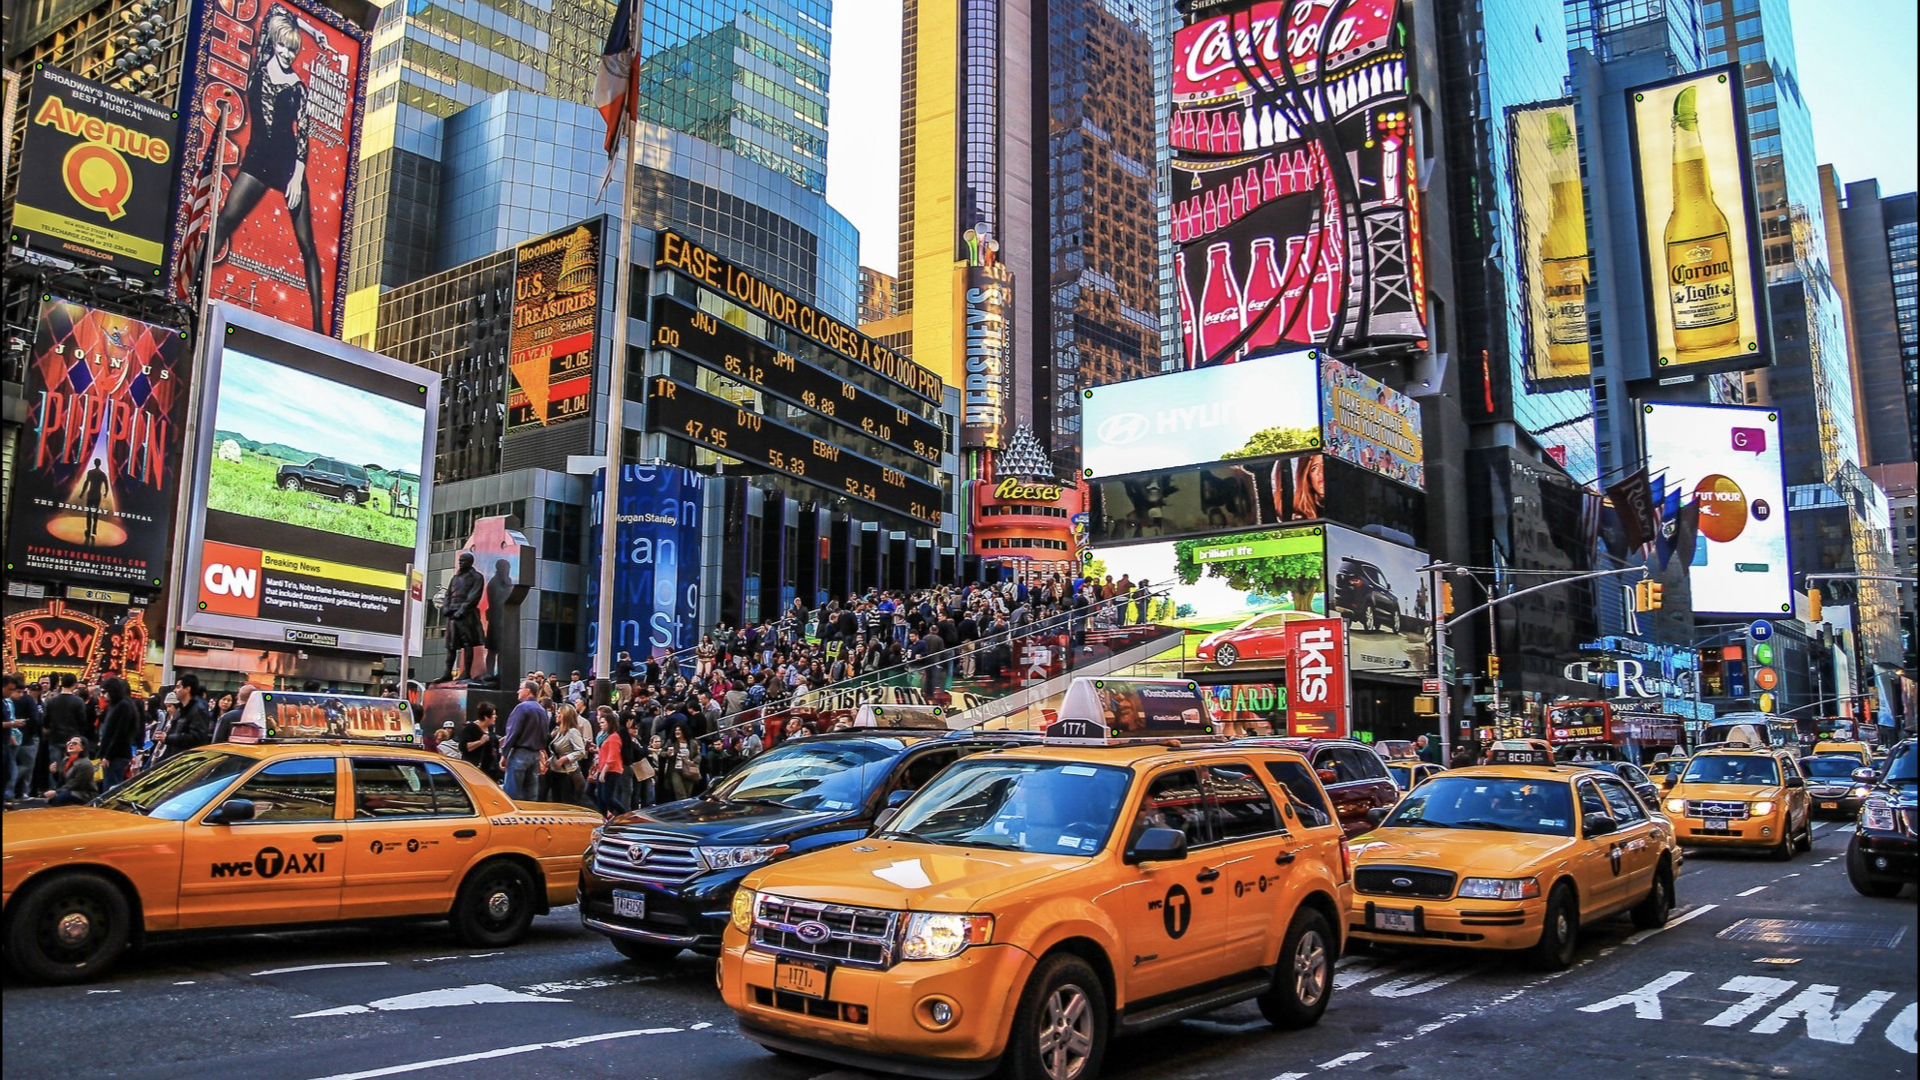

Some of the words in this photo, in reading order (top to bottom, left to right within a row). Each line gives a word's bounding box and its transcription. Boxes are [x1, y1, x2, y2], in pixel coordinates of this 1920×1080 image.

[43, 70, 103, 98] BROADWAY'S
[311, 60, 350, 92] LONGEST
[309, 74, 347, 107] RUNNING
[72, 90, 98, 105] BEST
[100, 99, 143, 121] MUSICAL
[305, 100, 343, 132] MUSICAL
[307, 90, 345, 119] AMERICAN
[35, 96, 170, 164] Avenue
[63, 142, 133, 221] Q
[41, 224, 95, 244] TELECHARGE.COM
[62, 242, 114, 260] AVENUEQ.COM
[519, 233, 575, 262] Bloomberg
[1672, 260, 1730, 286] Corona
[517, 272, 545, 301] U.S.
[656, 231, 723, 289] EASE:
[727, 265, 798, 328] LOUNOR
[800, 306, 858, 359] CLOSES
[861, 339, 871, 365] A
[1685, 283, 1720, 303] Light
[534, 326, 553, 340] YIELD
[560, 315, 593, 332] CHANGE
[691, 311, 717, 336] JNJ
[560, 350, 589, 370] -0.05
[966, 286, 1002, 424] HERSHEY'S
[1004, 319, 1012, 376] CHOCOLATE
[55, 344, 123, 369] JOIN
[141, 365, 170, 380] US
[724, 355, 764, 386] 85.12
[773, 351, 795, 373] JPM
[649, 379, 677, 400] TR
[802, 390, 835, 416] 48.88
[842, 382, 856, 400] KO
[1338, 389, 1360, 416] MAKE
[557, 395, 586, 413] -0.04
[861, 417, 891, 440] 42.10
[897, 409, 909, 426] LH
[29, 390, 168, 491] PIPPIN
[685, 420, 727, 449] 47.95
[813, 439, 839, 462] EBAY
[914, 439, 940, 460] 93.67
[1734, 433, 1747, 447] G
[769, 449, 804, 476] 56.33
[883, 467, 905, 488] EQIX
[846, 478, 876, 500] 52.54
[993, 477, 1063, 501] Reese's
[1714, 492, 1741, 502] YOUR
[34, 498, 54, 507] THE
[58, 502, 109, 515] BROADWAY
[113, 511, 153, 522] MUSICAL
[645, 513, 678, 526] Stanley
[911, 502, 941, 523] 211.49
[1757, 506, 1767, 514] m
[27, 554, 91, 567] TELECHARGE.COM
[264, 556, 298, 571] Breaking
[299, 562, 321, 573] News
[1199, 547, 1234, 560] brilliant
[1236, 545, 1253, 557] life
[204, 563, 257, 599] CNN
[266, 577, 283, 587] Manti
[299, 583, 315, 593] Notre
[316, 585, 332, 595] Dame
[333, 588, 360, 599] linebacker
[360, 593, 382, 603] involved
[95, 591, 112, 601] CBS
[264, 597, 292, 608] Chargers
[299, 601, 318, 611] Round
[265, 588, 278, 597] that
[279, 590, 302, 600] included
[303, 593, 335, 604] nonexistent
[361, 601, 380, 611] drafted
[381, 604, 388, 612] by
[1621, 585, 1643, 636] R
[15, 621, 92, 658] ROXY
[1755, 627, 1766, 635] m
[1300, 626, 1334, 703] tkts
[1614, 660, 1660, 699] R
[1764, 674, 1773, 682] m
[1219, 687, 1288, 711] GARDE
[277, 703, 327, 727] IRON
[347, 707, 385, 731] MAN
[389, 709, 402, 731] 3
[1062, 722, 1087, 735] 1T71
[1508, 753, 1532, 762] 8C30
[211, 861, 253, 878] NYC
[255, 847, 325, 879] TAXI
[1148, 900, 1163, 911] NYC
